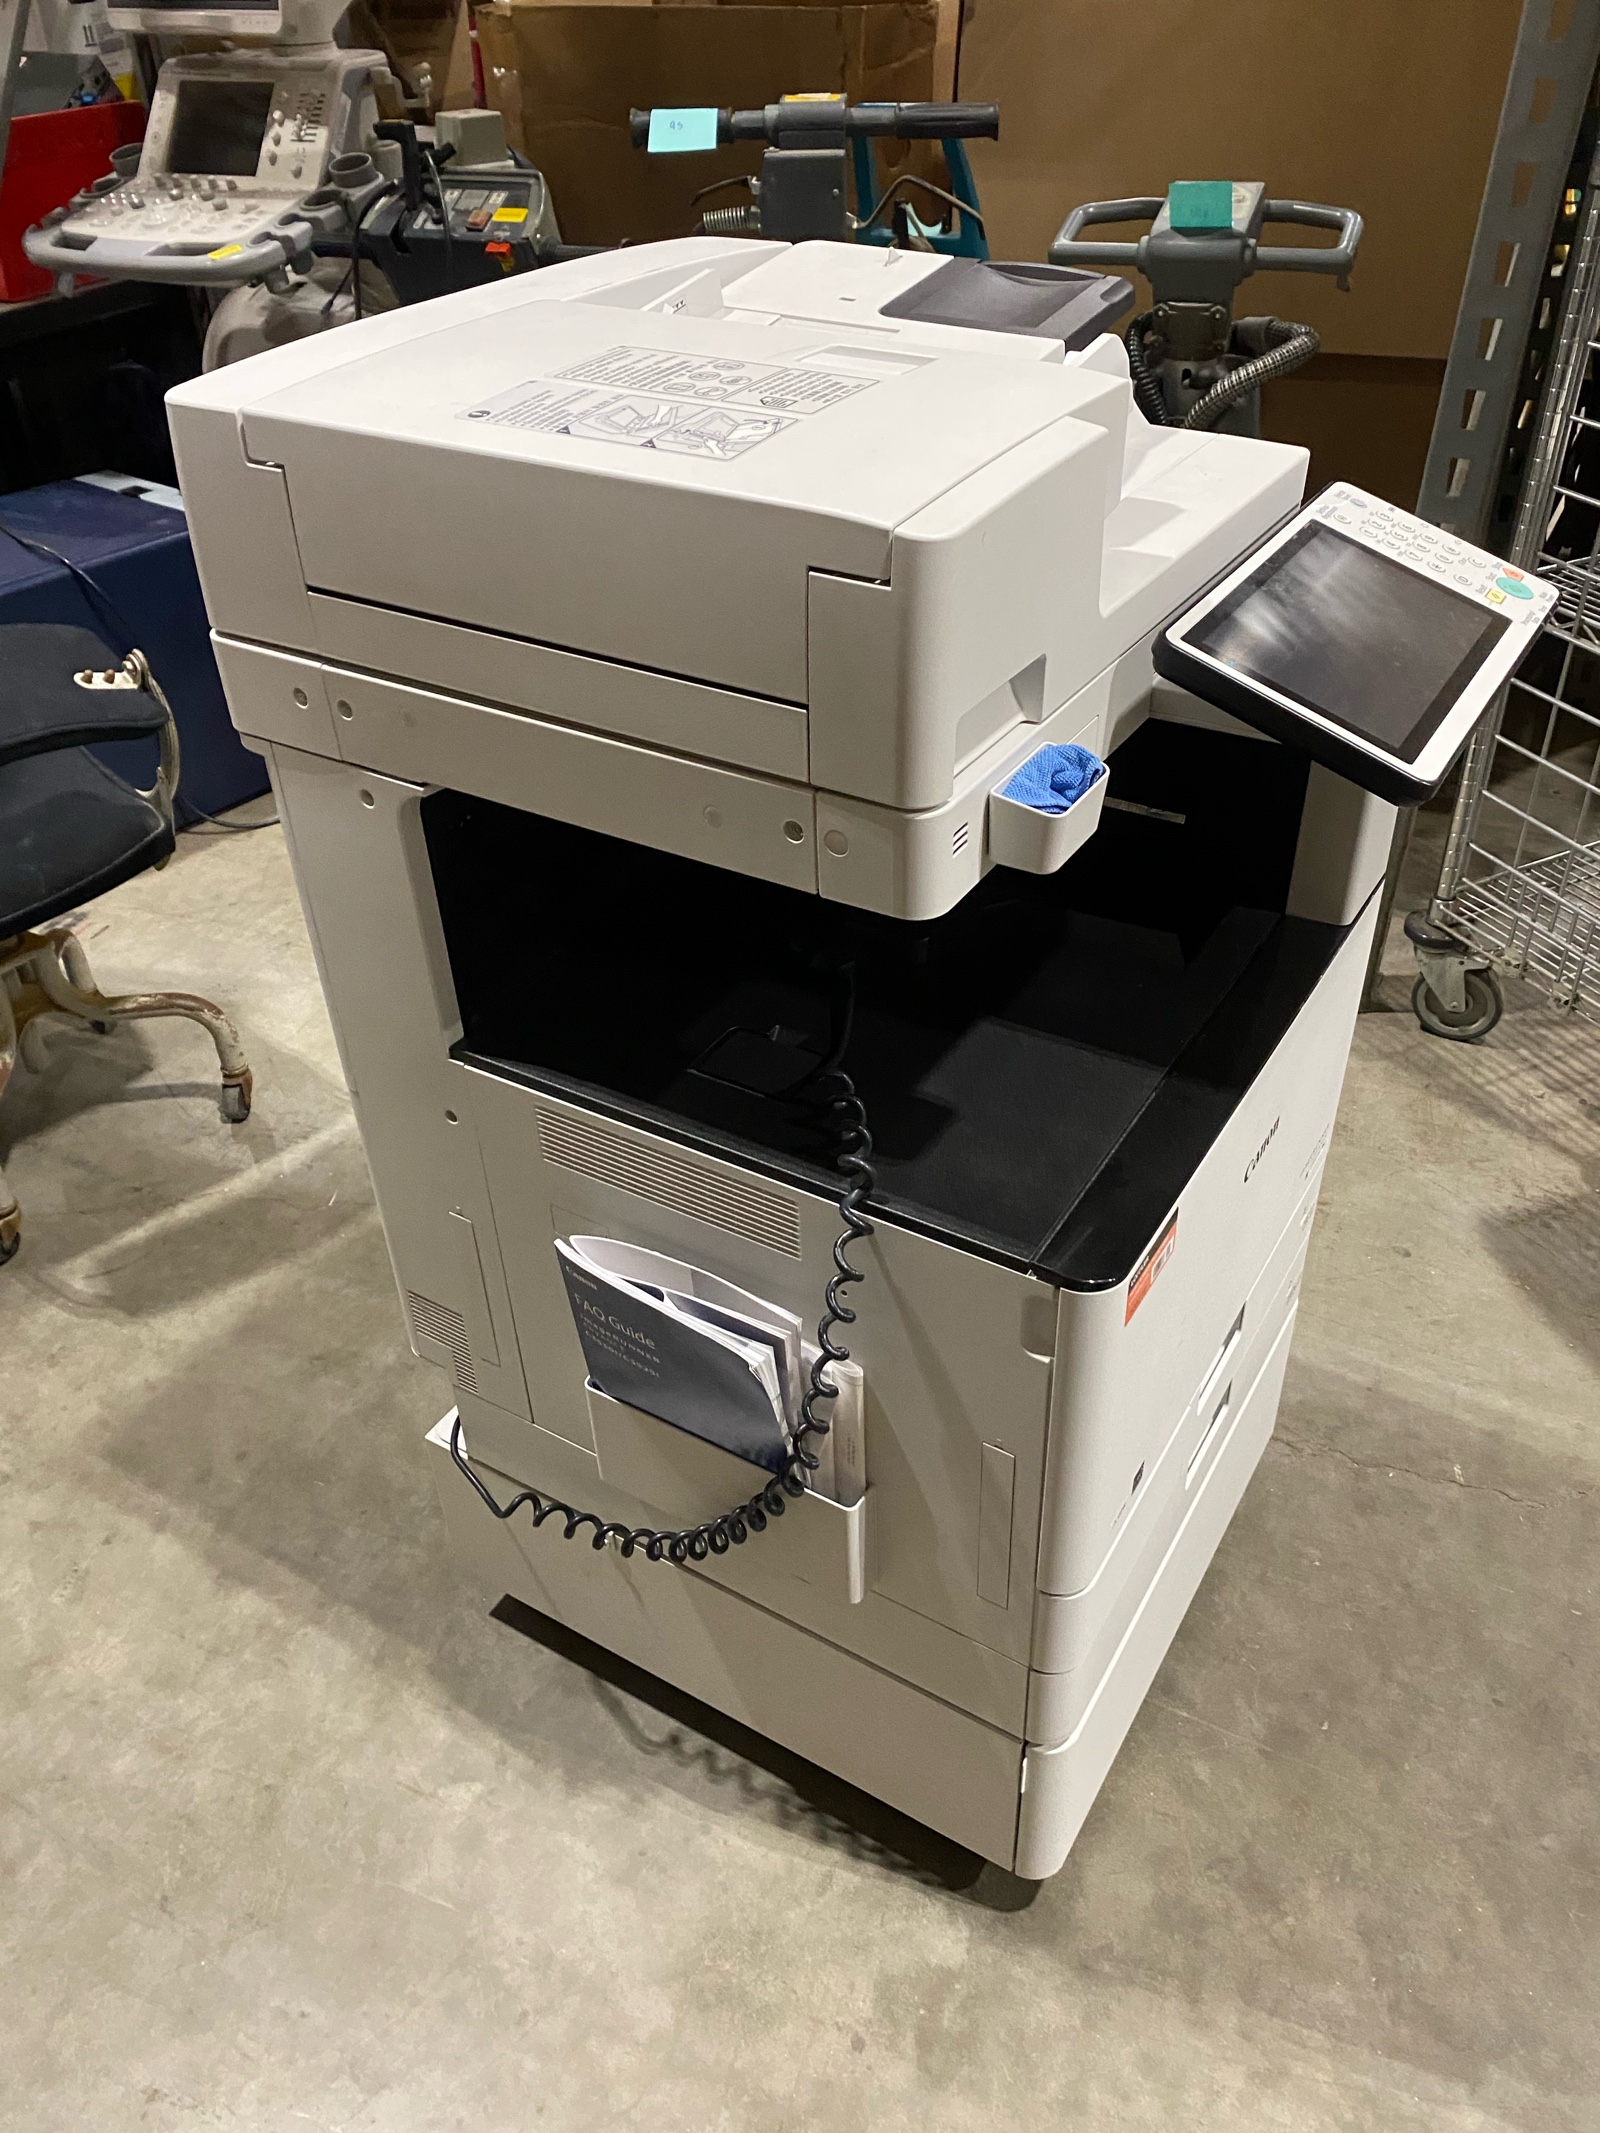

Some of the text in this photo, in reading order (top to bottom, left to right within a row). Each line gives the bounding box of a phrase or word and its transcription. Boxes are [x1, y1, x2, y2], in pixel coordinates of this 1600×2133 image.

[1243, 1115, 1280, 1183] Canon
[574, 1293, 656, 1350] FAQ Guide
